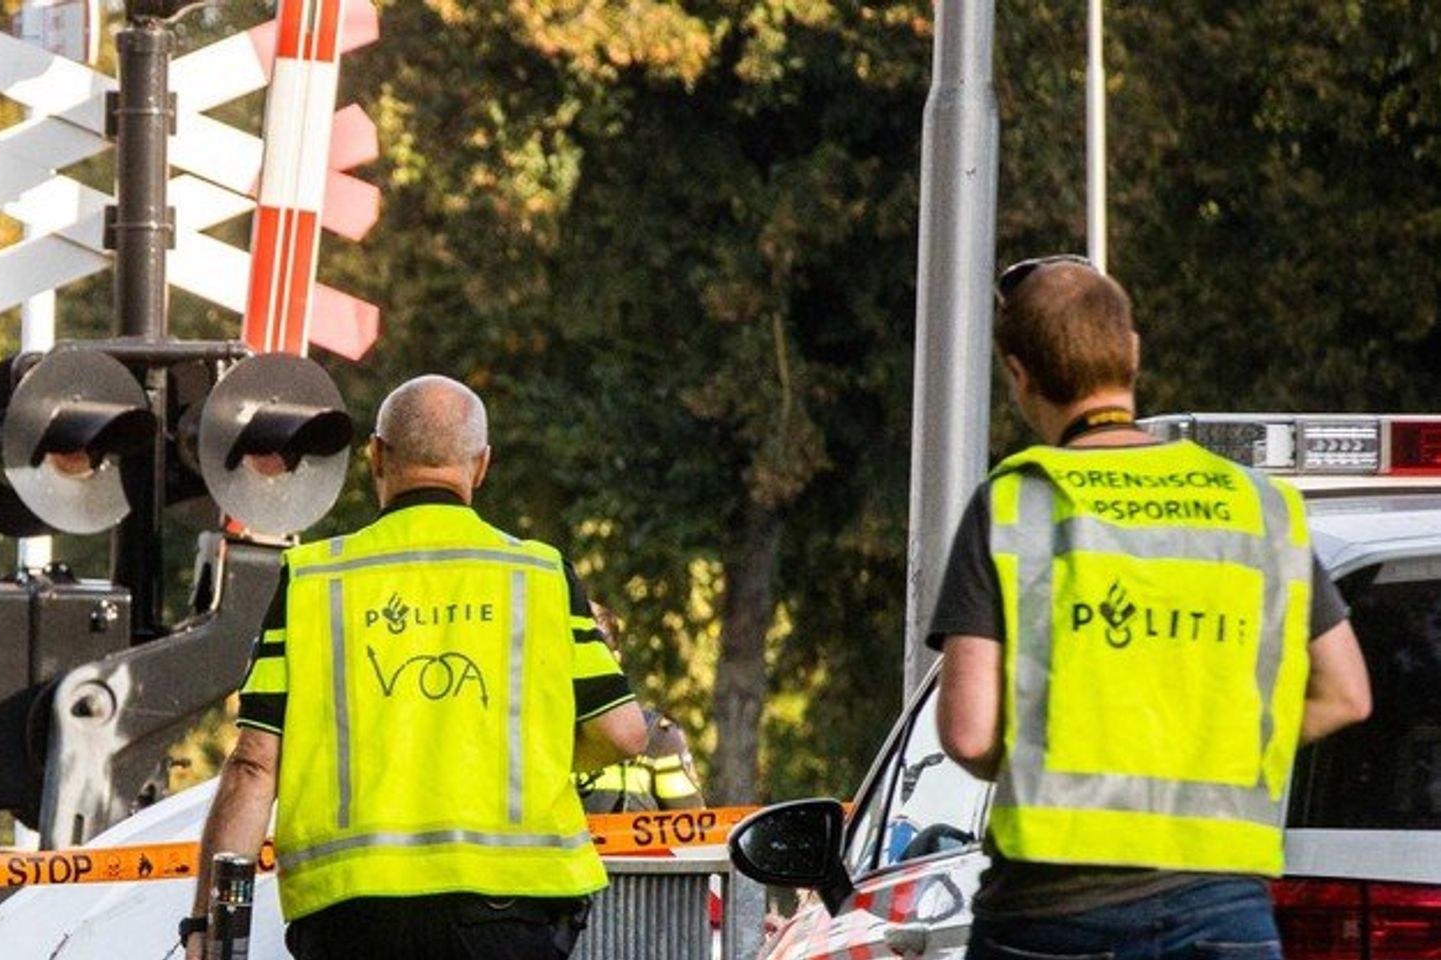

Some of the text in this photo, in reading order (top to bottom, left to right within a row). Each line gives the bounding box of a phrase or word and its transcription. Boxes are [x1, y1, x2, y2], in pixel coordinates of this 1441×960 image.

[1086, 499, 1231, 520] PSPORING
[365, 593, 493, 634] POLITIE
[367, 646, 489, 710] VOA
[632, 812, 716, 846] STOP
[7, 855, 92, 886] STOP
